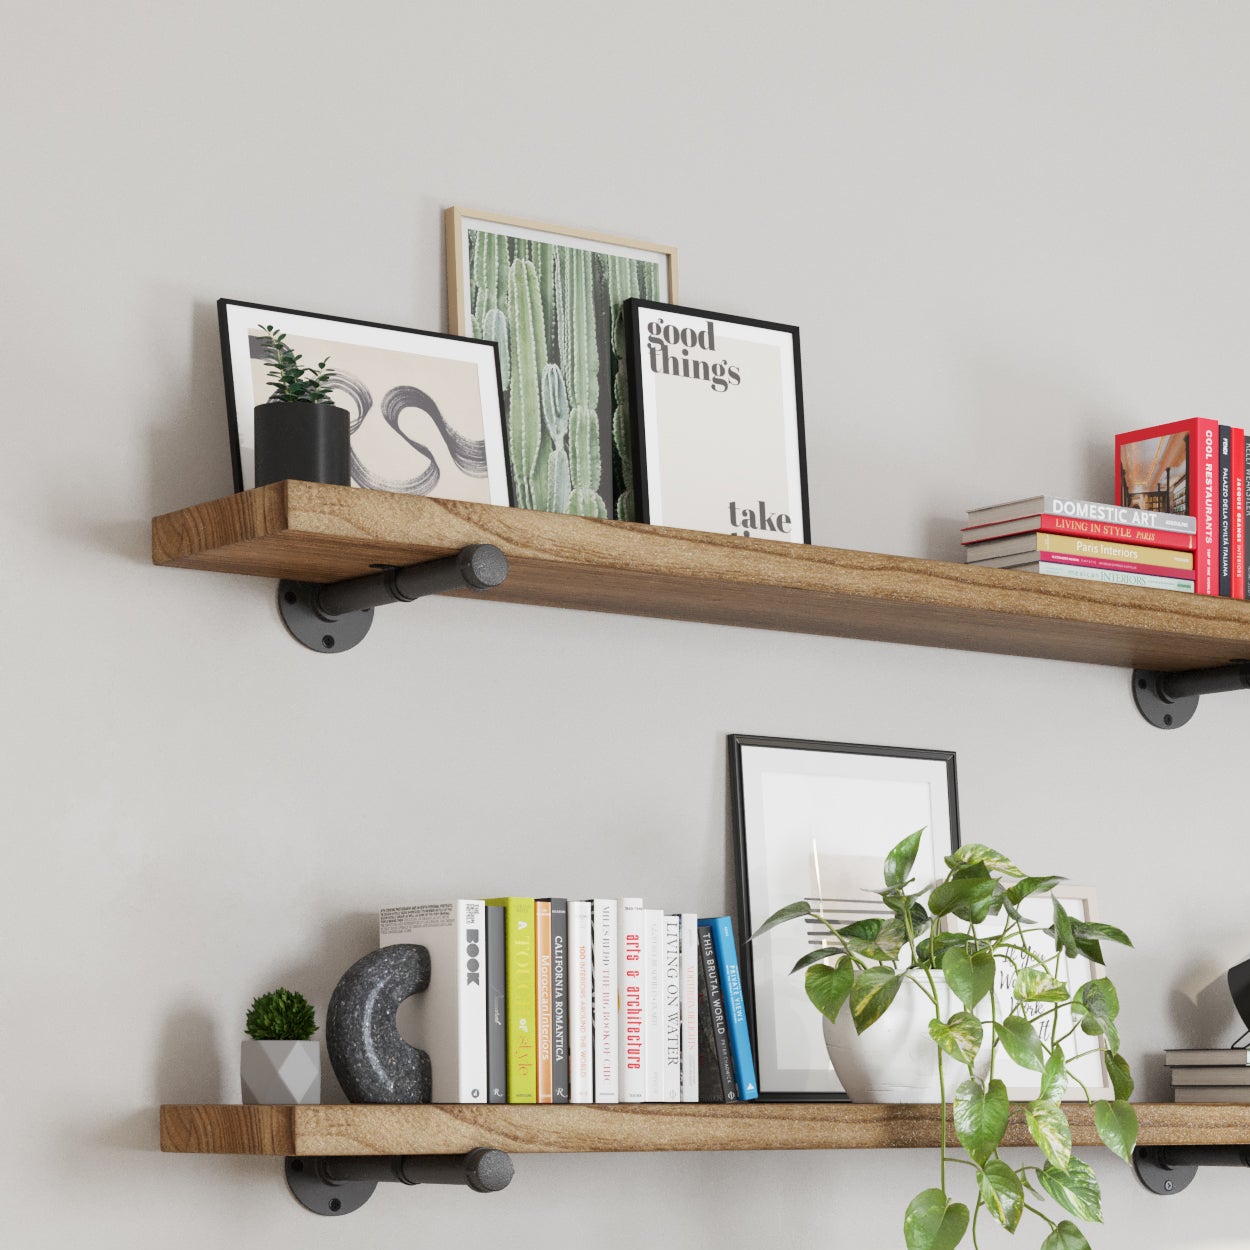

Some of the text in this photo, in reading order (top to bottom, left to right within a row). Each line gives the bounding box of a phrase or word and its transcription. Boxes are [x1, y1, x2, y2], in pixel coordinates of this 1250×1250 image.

[648, 318, 716, 351] good
[648, 345, 740, 392] things
[728, 501, 792, 534] take
[1052, 500, 1157, 527] DOMESTIC ART
[1056, 519, 1155, 541] LIVING IN STYLE PARIS
[1076, 540, 1138, 559] Paris Interiors
[1101, 571, 1146, 586] INTERIORS
[518, 921, 527, 930] A
[466, 929, 479, 986] BOOK
[601, 938, 610, 966] REDD
[626, 934, 641, 961] arts
[702, 933, 712, 956] THIS
[601, 970, 610, 987] THE
[706, 959, 718, 997] BRUTAL
[729, 965, 739, 996] PRIVATE
[555, 936, 563, 1061] CALIFORNIA ROMANTICA
[601, 992, 610, 1009] BIG
[666, 922, 678, 1066] LIVING ON WATER
[519, 1018, 528, 1032] OF
[713, 999, 724, 1035] WORLD
[733, 999, 743, 1023] VIEWS
[601, 1011, 610, 1040] BOOK
[626, 986, 642, 1069] architecture
[513, 1036, 533, 1076] style
[601, 1042, 610, 1056] OF
[722, 1055, 732, 1083] CHADWICK
